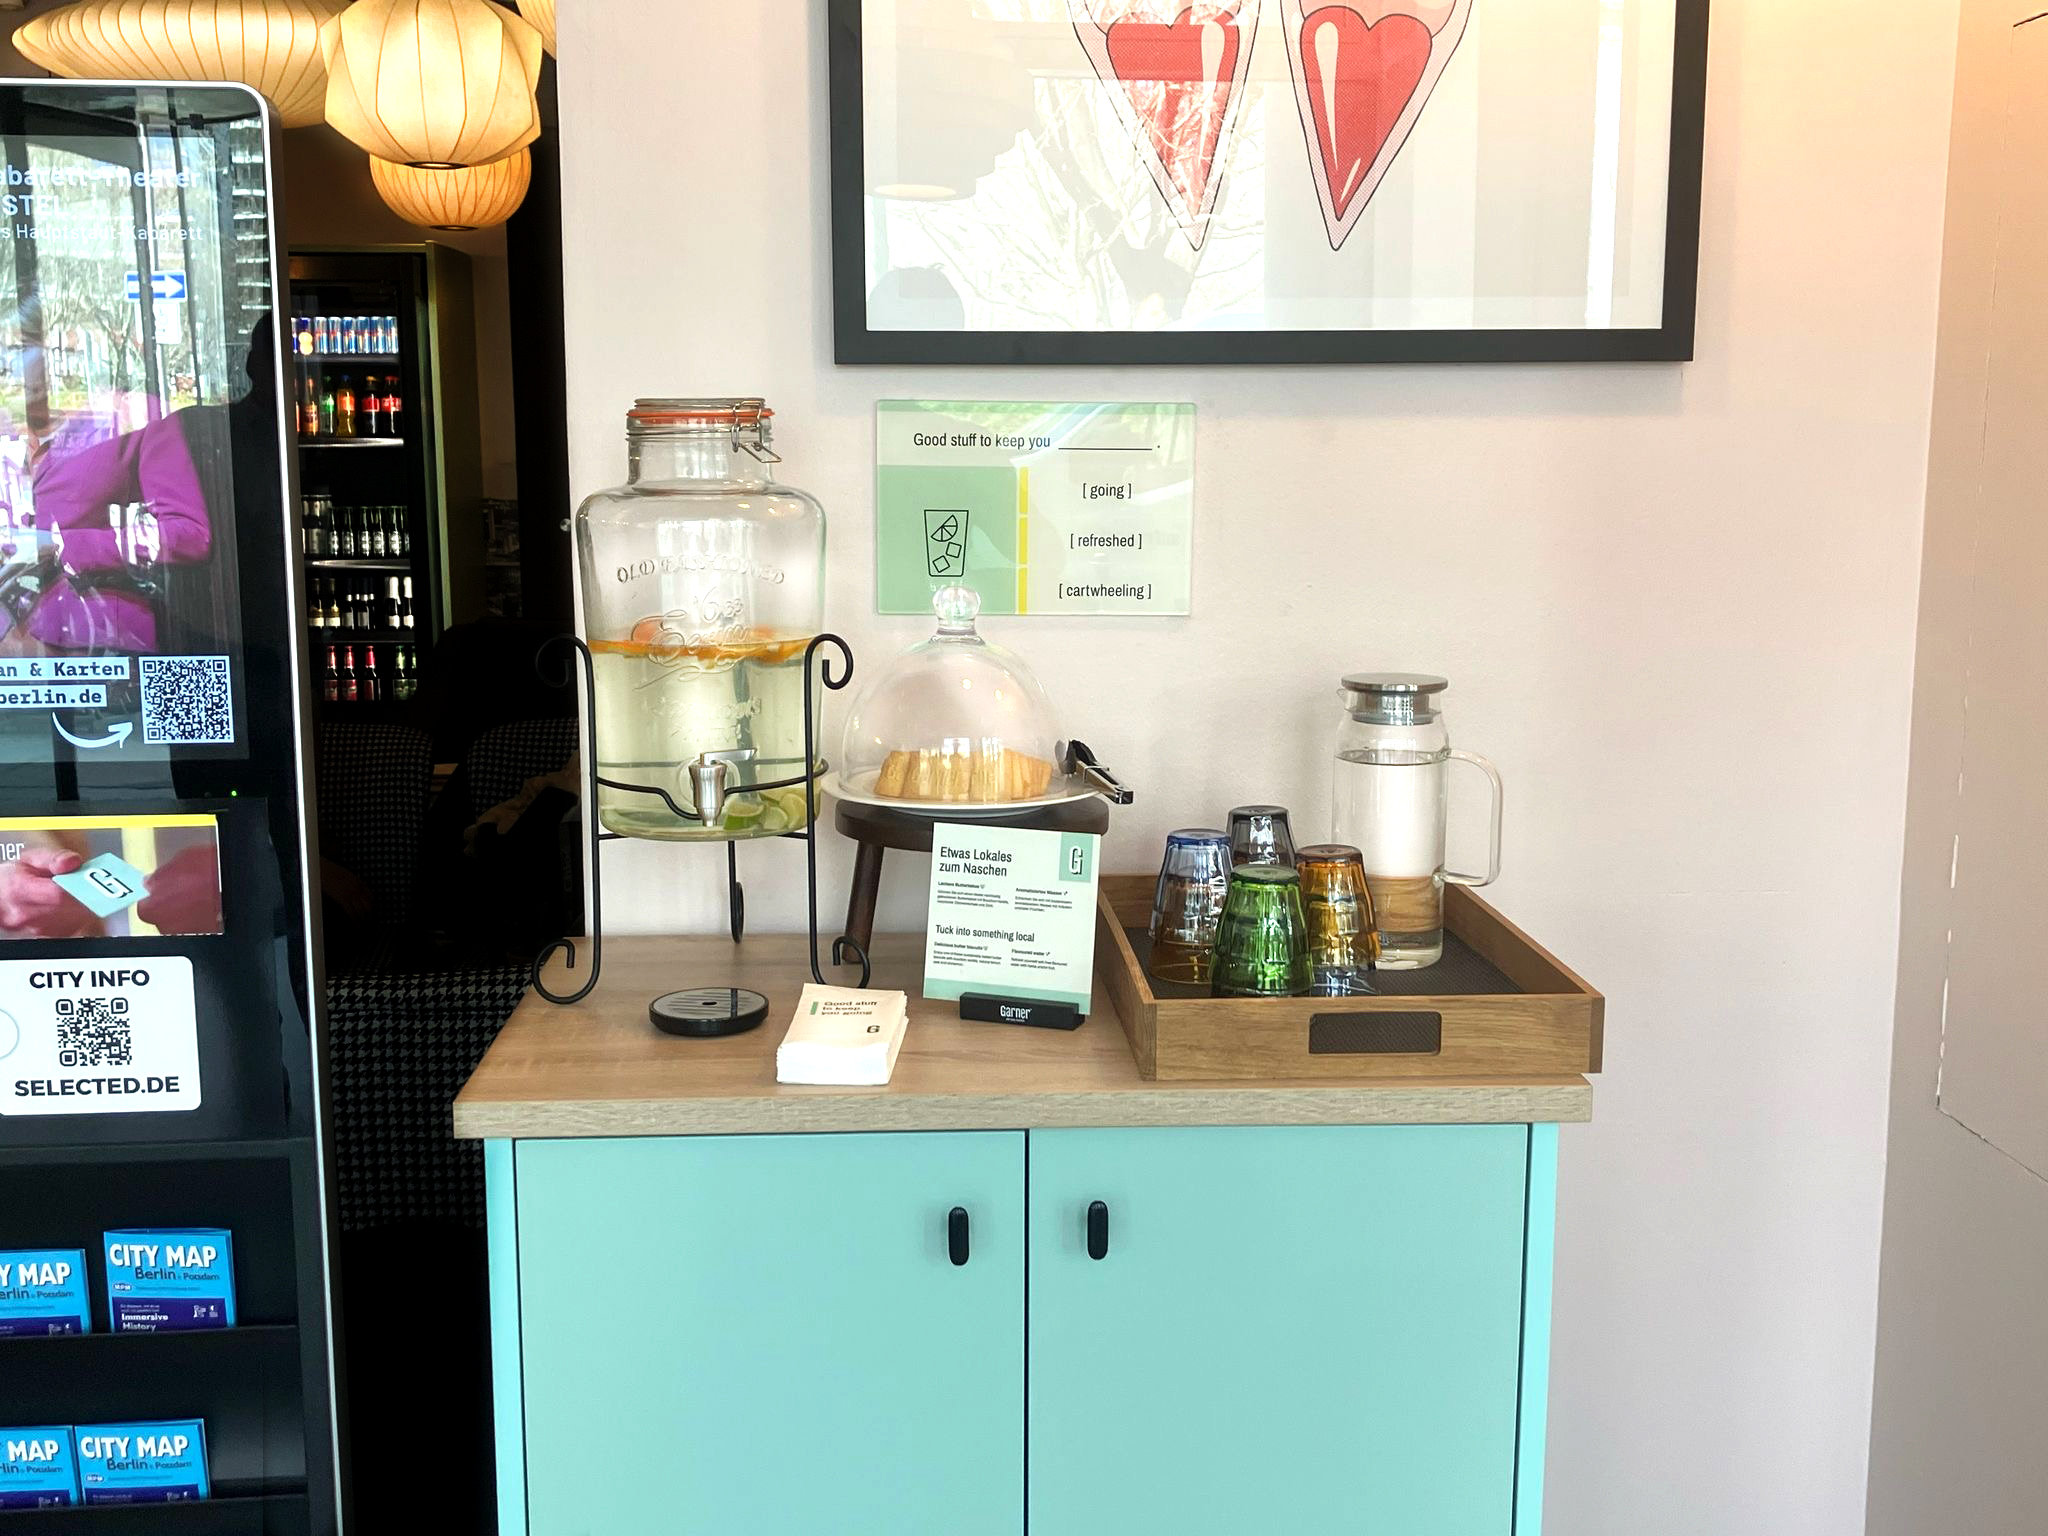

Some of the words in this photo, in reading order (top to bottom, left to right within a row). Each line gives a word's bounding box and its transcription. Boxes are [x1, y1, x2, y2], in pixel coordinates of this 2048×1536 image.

[913, 432, 947, 447] Good
[951, 433, 977, 447] stuff
[980, 434, 991, 447] to
[995, 434, 1025, 450] keep
[1028, 437, 1051, 451] you
[30, 662, 42, 677] &
[54, 661, 125, 677] Karten
[940, 846, 971, 860] Etwas
[973, 848, 1012, 863] Lokales
[939, 862, 960, 873] zum
[963, 862, 1007, 877] Naschen
[935, 924, 954, 935] Tuck
[956, 926, 971, 937] into
[973, 928, 1014, 943] something
[1015, 931, 1035, 943] local
[29, 970, 84, 989] CITY
[91, 969, 150, 987] INFO
[1000, 1005, 1031, 1020] Garner
[15, 1076, 180, 1097] SELECTED.DE
[109, 1243, 159, 1267] CITY
[166, 1245, 217, 1268] MAP
[18, 1262, 71, 1287] MAP
[135, 1267, 176, 1280] Berlin
[121, 1312, 169, 1321] Immersive
[122, 1321, 156, 1333] History
[7, 1439, 59, 1462] MAP
[80, 1436, 130, 1459] CITY
[136, 1435, 189, 1458] MAP
[107, 1458, 148, 1471] Berlin
